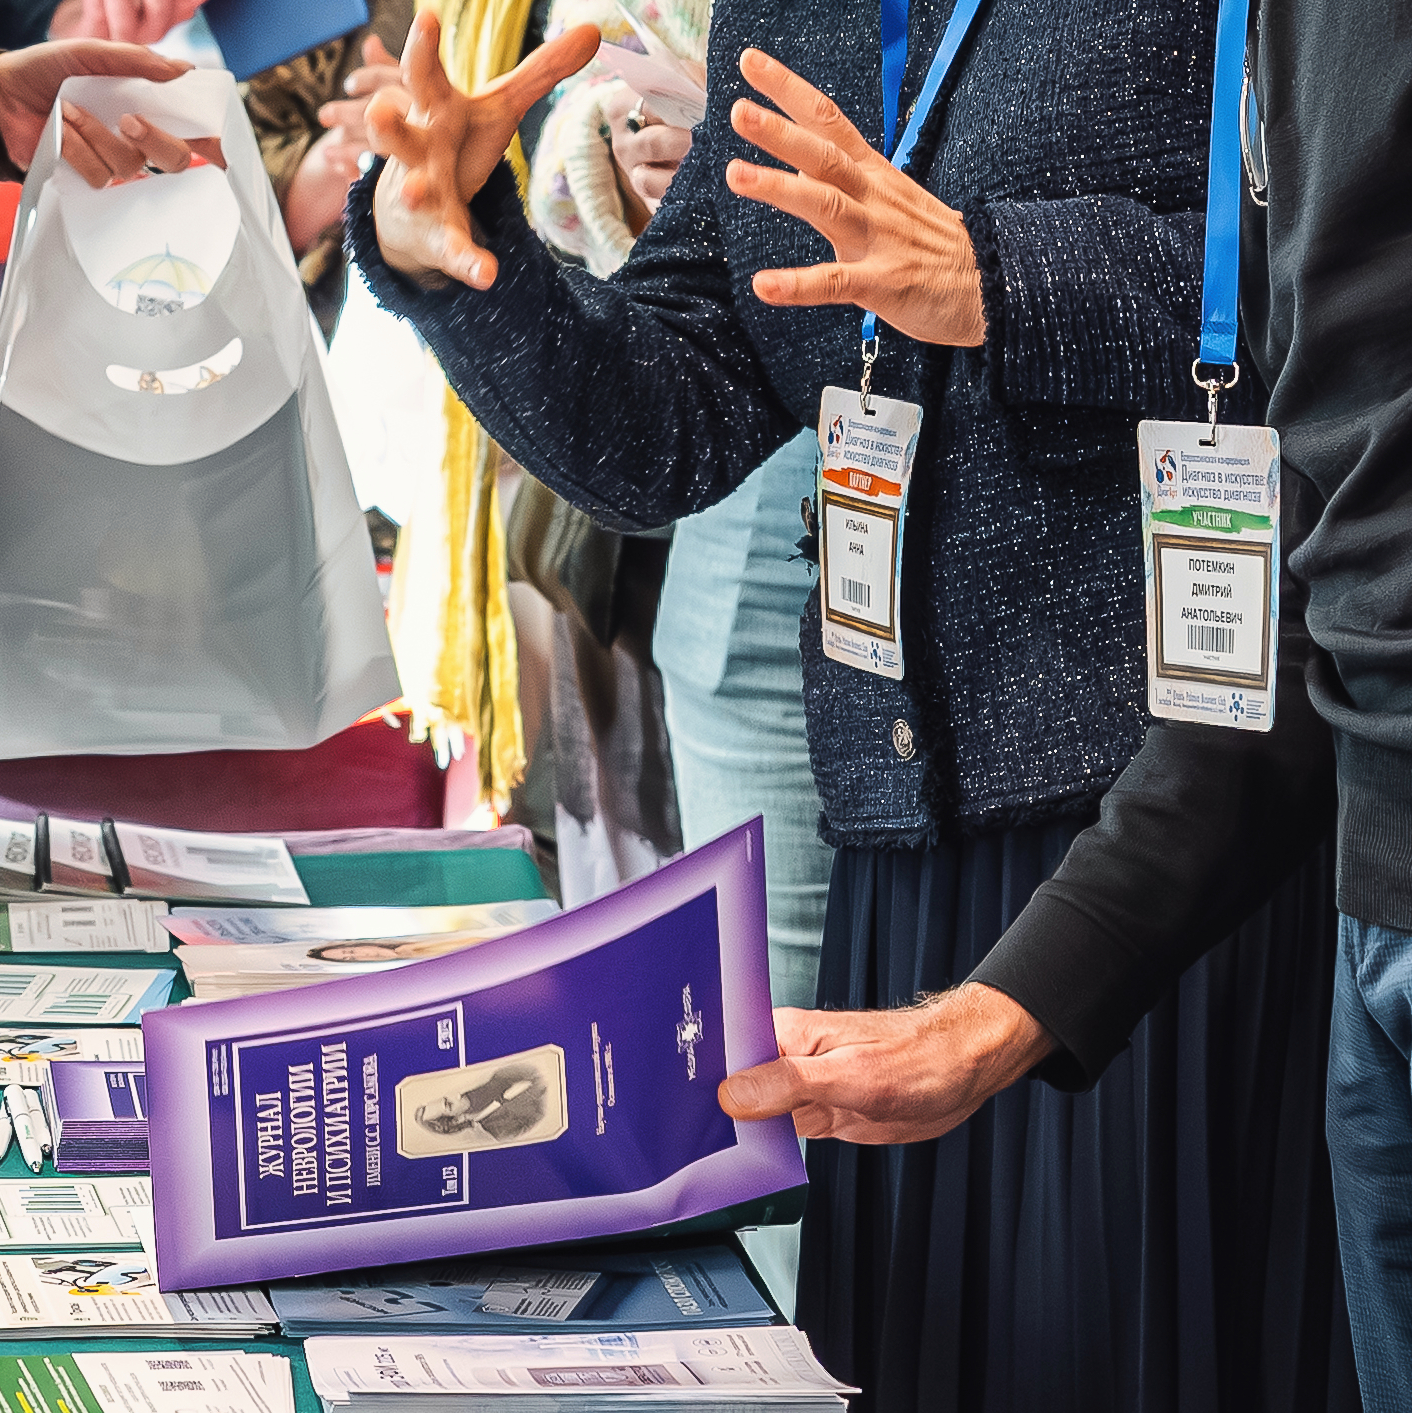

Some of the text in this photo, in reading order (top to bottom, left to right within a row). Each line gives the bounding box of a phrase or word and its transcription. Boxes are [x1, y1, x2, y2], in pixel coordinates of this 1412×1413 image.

[1181, 464, 1216, 483] Диагноз
[1191, 510, 1232, 528] УЧАСТНИК
[1188, 558, 1235, 574] ПОТЕМКИН
[1191, 582, 1233, 598] ДМИТРИЙ
[1181, 607, 1243, 624] АНАТОЛЬЕВИЧ
[288, 1061, 319, 1196] НЕВРОЛОГИИ
[321, 1041, 352, 1206] И ПСИХИАТРИИ
[255, 1091, 285, 1179] ЖУРНАЛ
[366, 1146, 381, 1187] ИМЕНИ
